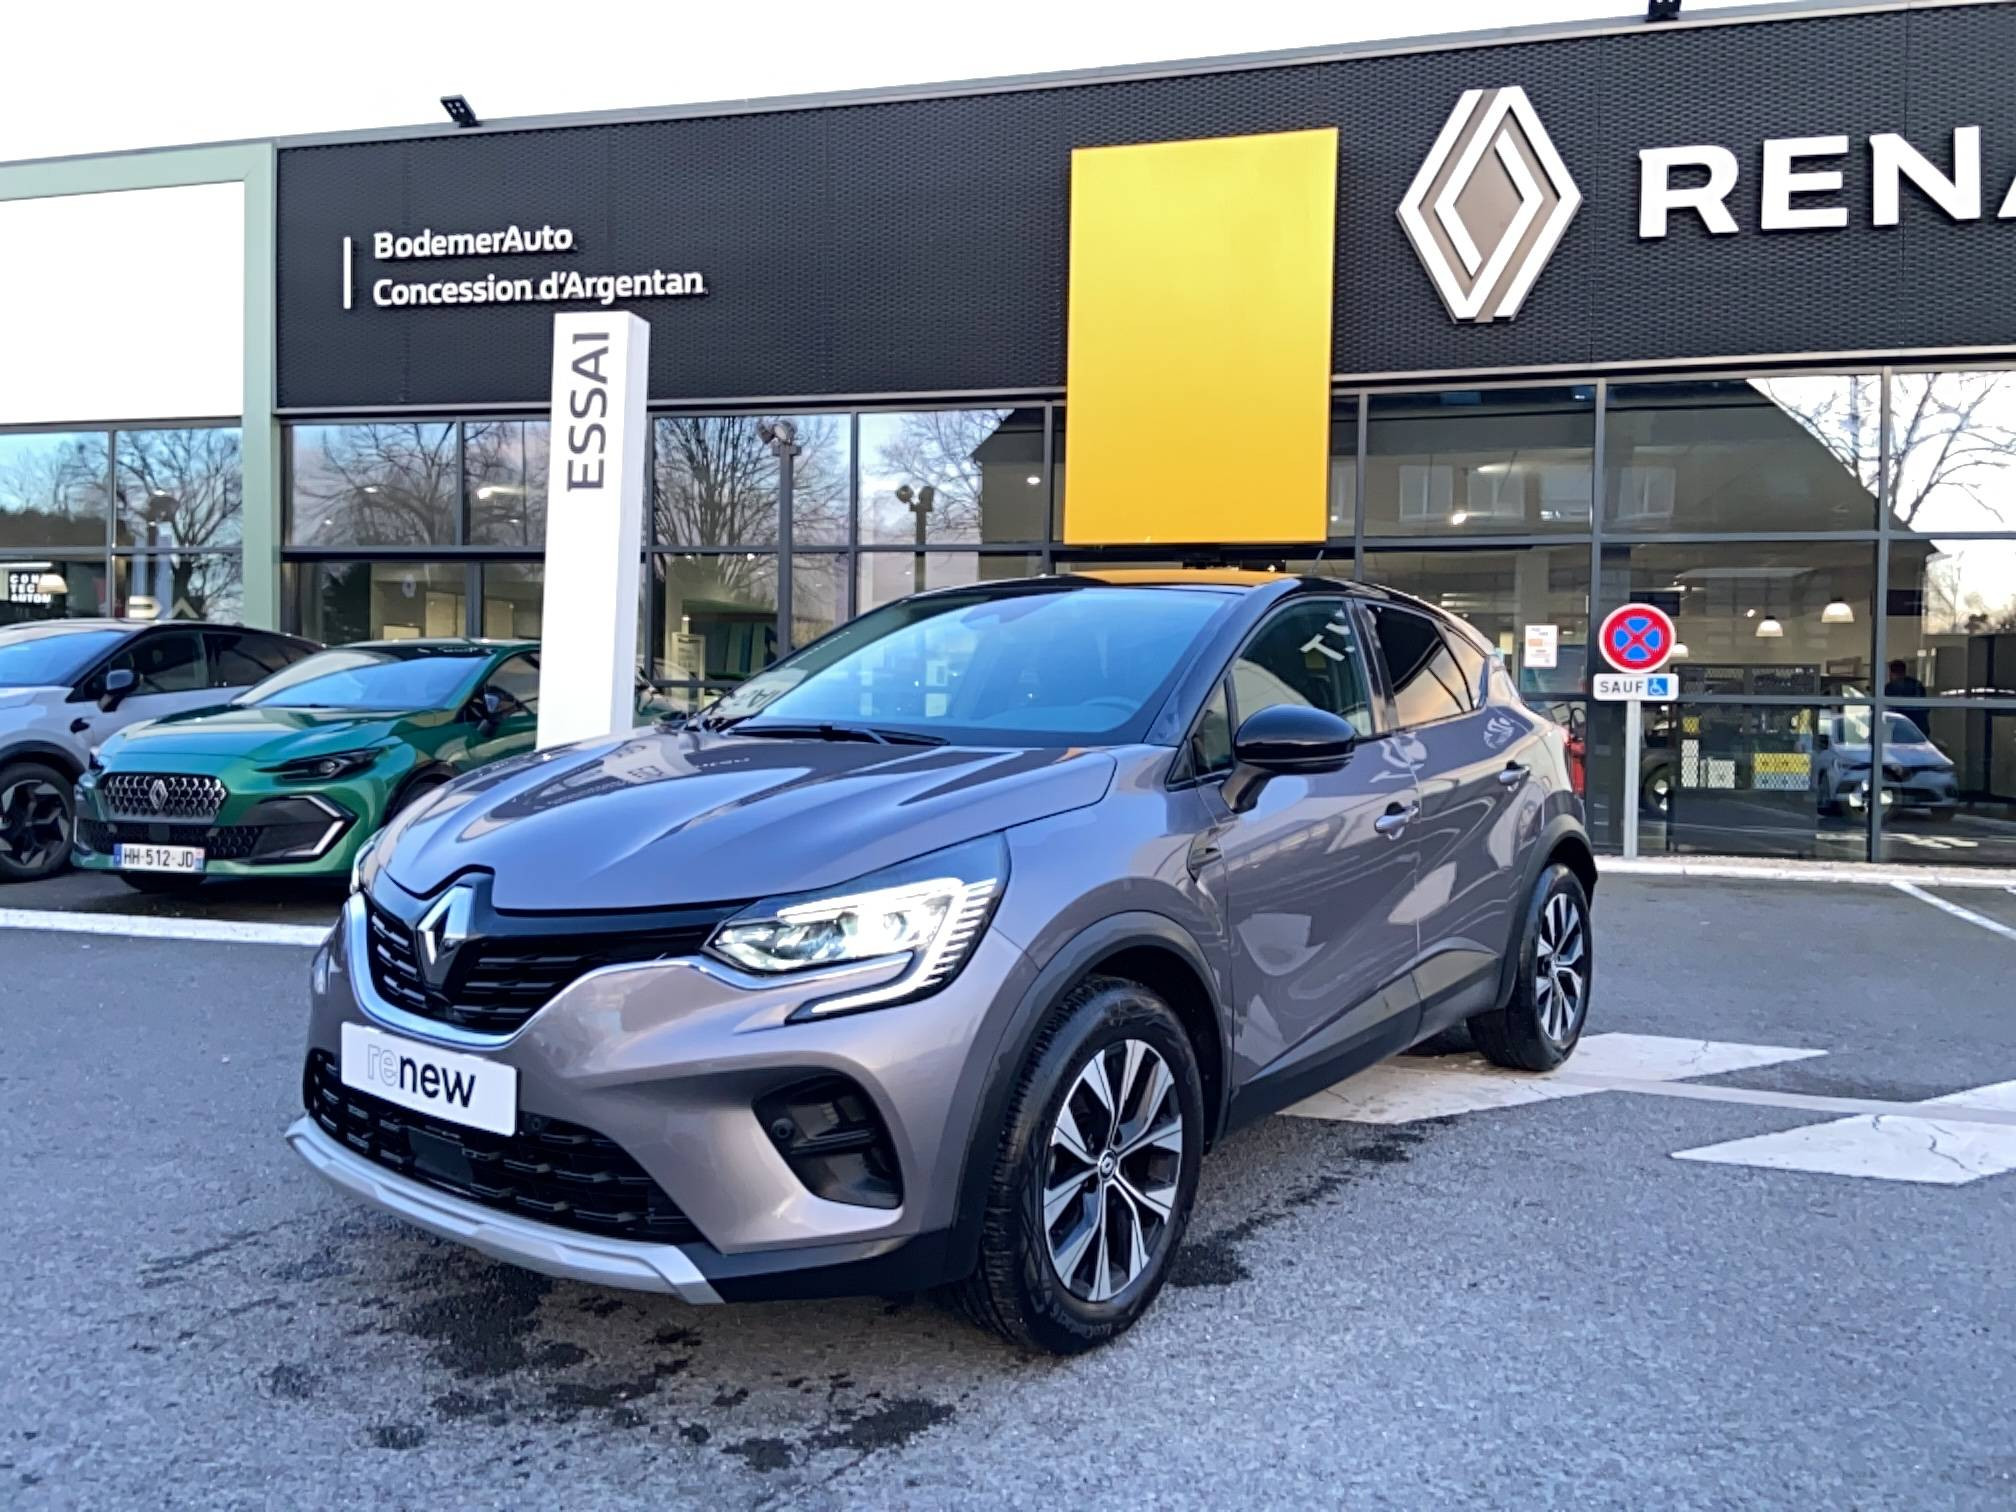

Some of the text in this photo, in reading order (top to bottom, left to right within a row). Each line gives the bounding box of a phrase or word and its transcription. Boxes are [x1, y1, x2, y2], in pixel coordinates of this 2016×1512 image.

[1638, 125, 2016, 238] REN
[373, 225, 573, 260] BodemerAuto
[372, 269, 704, 306] Concession d'Argentan
[566, 332, 610, 492] ESSAI
[1599, 680, 1644, 694] SAUF
[124, 847, 194, 868] HH-512-JD
[367, 1043, 476, 1108] renew
